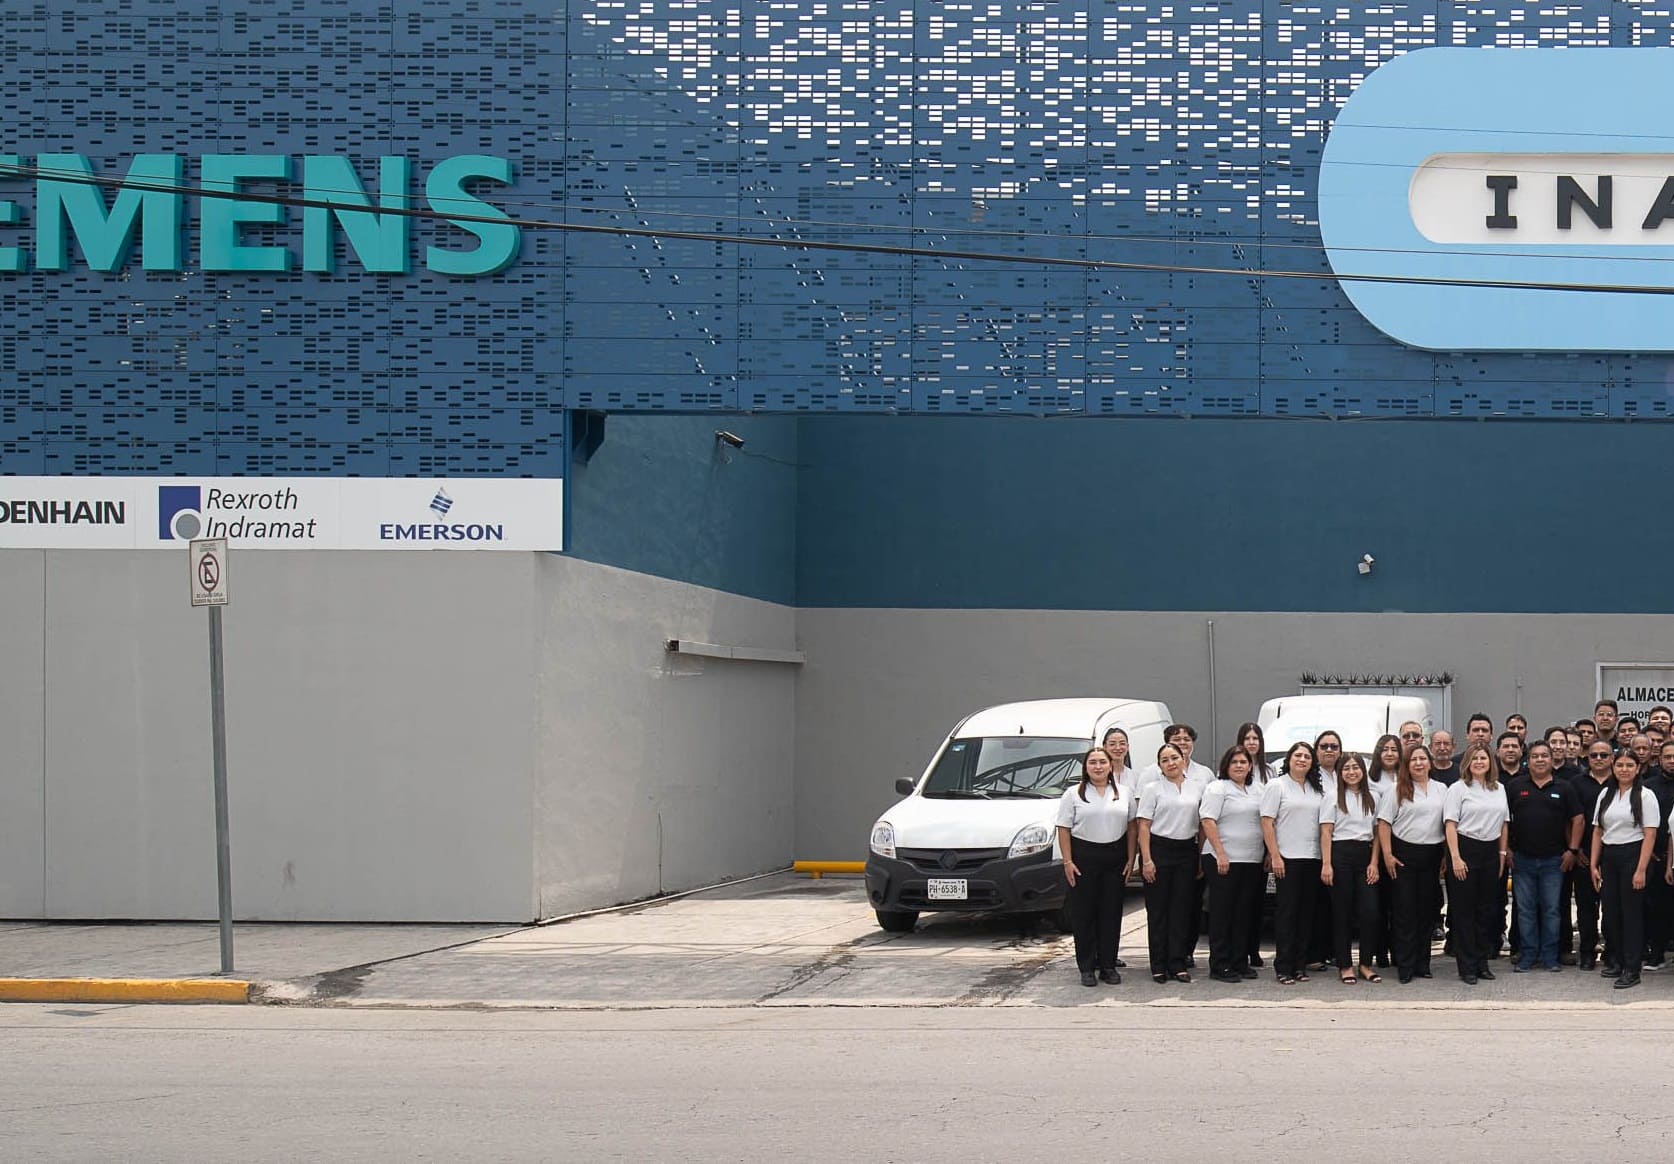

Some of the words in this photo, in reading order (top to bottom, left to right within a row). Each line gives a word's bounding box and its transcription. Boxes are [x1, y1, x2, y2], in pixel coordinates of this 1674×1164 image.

[0, 154, 520, 276] MENS
[207, 487, 299, 510] Rexroth
[206, 515, 317, 539] Indramat
[380, 524, 503, 541] EMERSON
